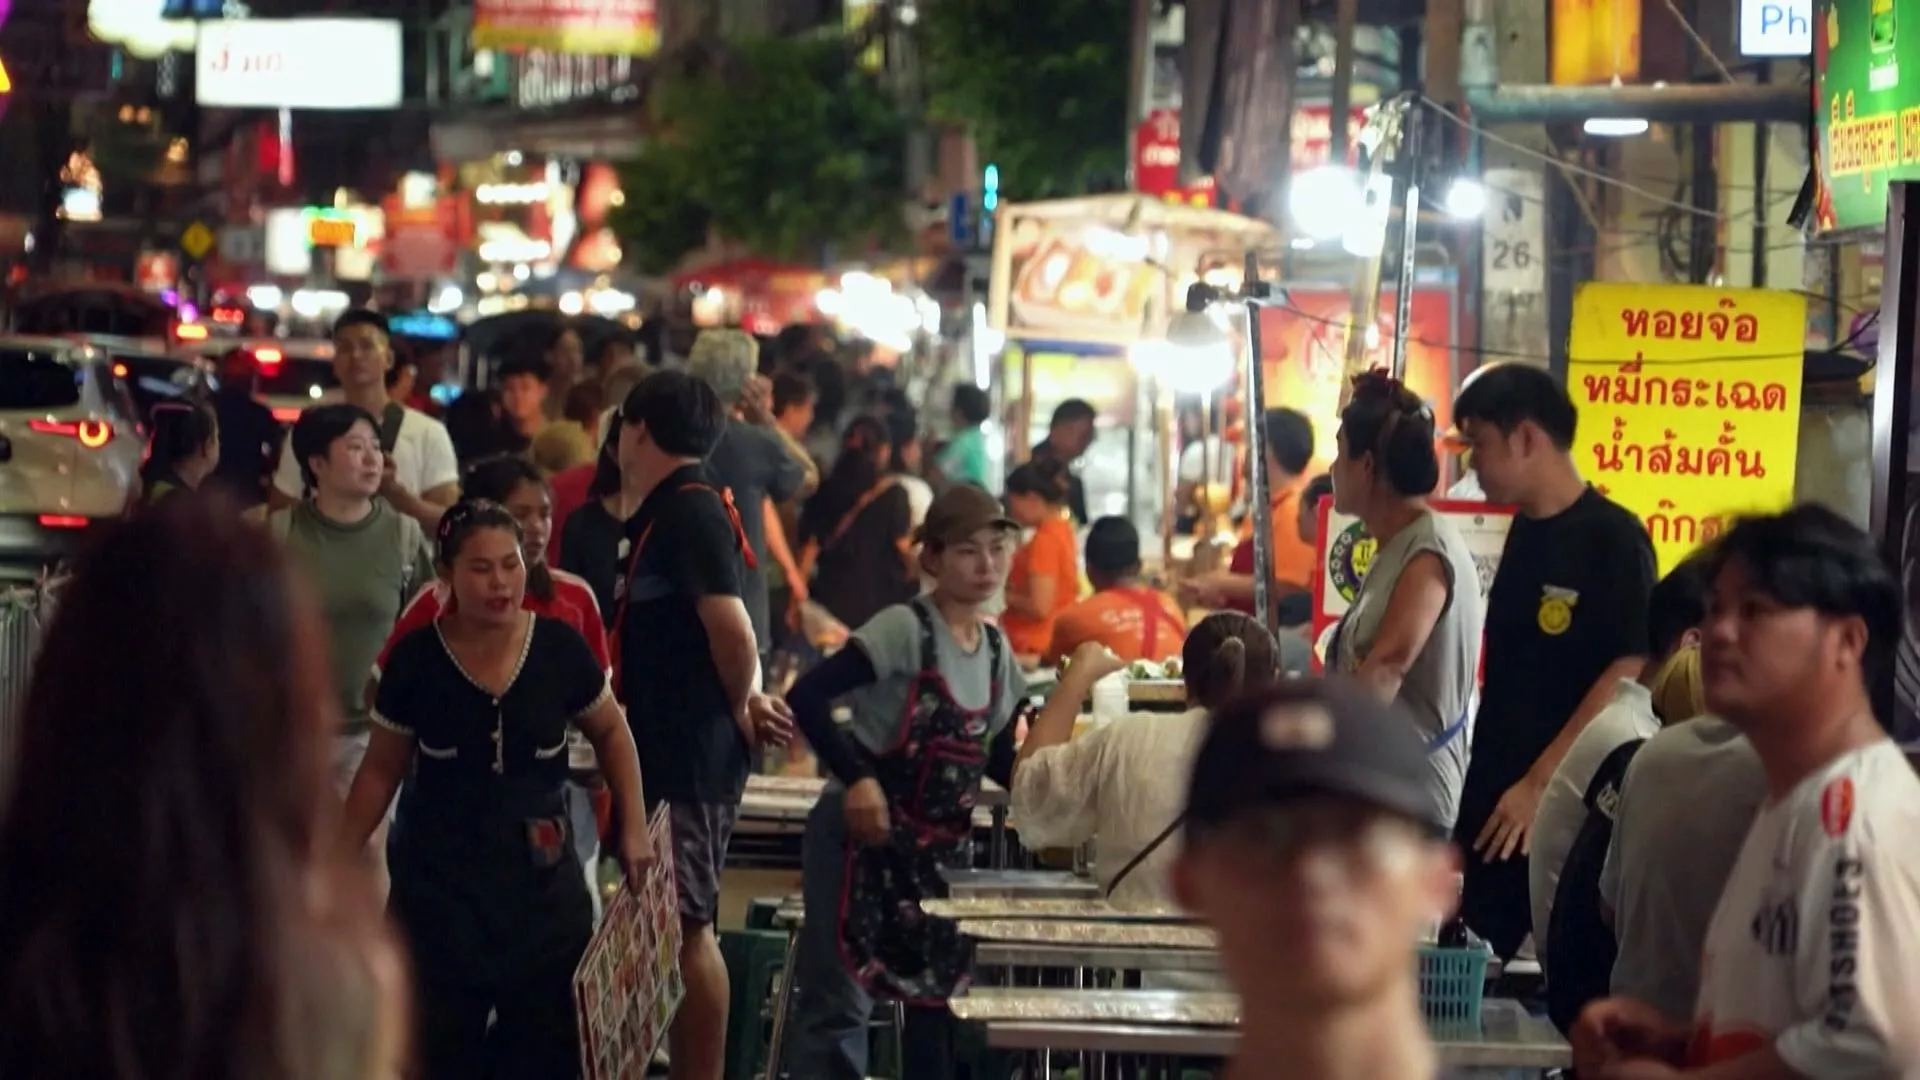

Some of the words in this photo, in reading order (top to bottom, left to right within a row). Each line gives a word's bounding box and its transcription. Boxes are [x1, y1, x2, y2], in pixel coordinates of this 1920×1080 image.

[1492, 240, 1530, 270] 26
[1621, 297, 1758, 343] หอยจ๊อ
[1583, 351, 1788, 411] หมี่กระเฉด
[1592, 416, 1766, 479] น้ำส้มคั้น
